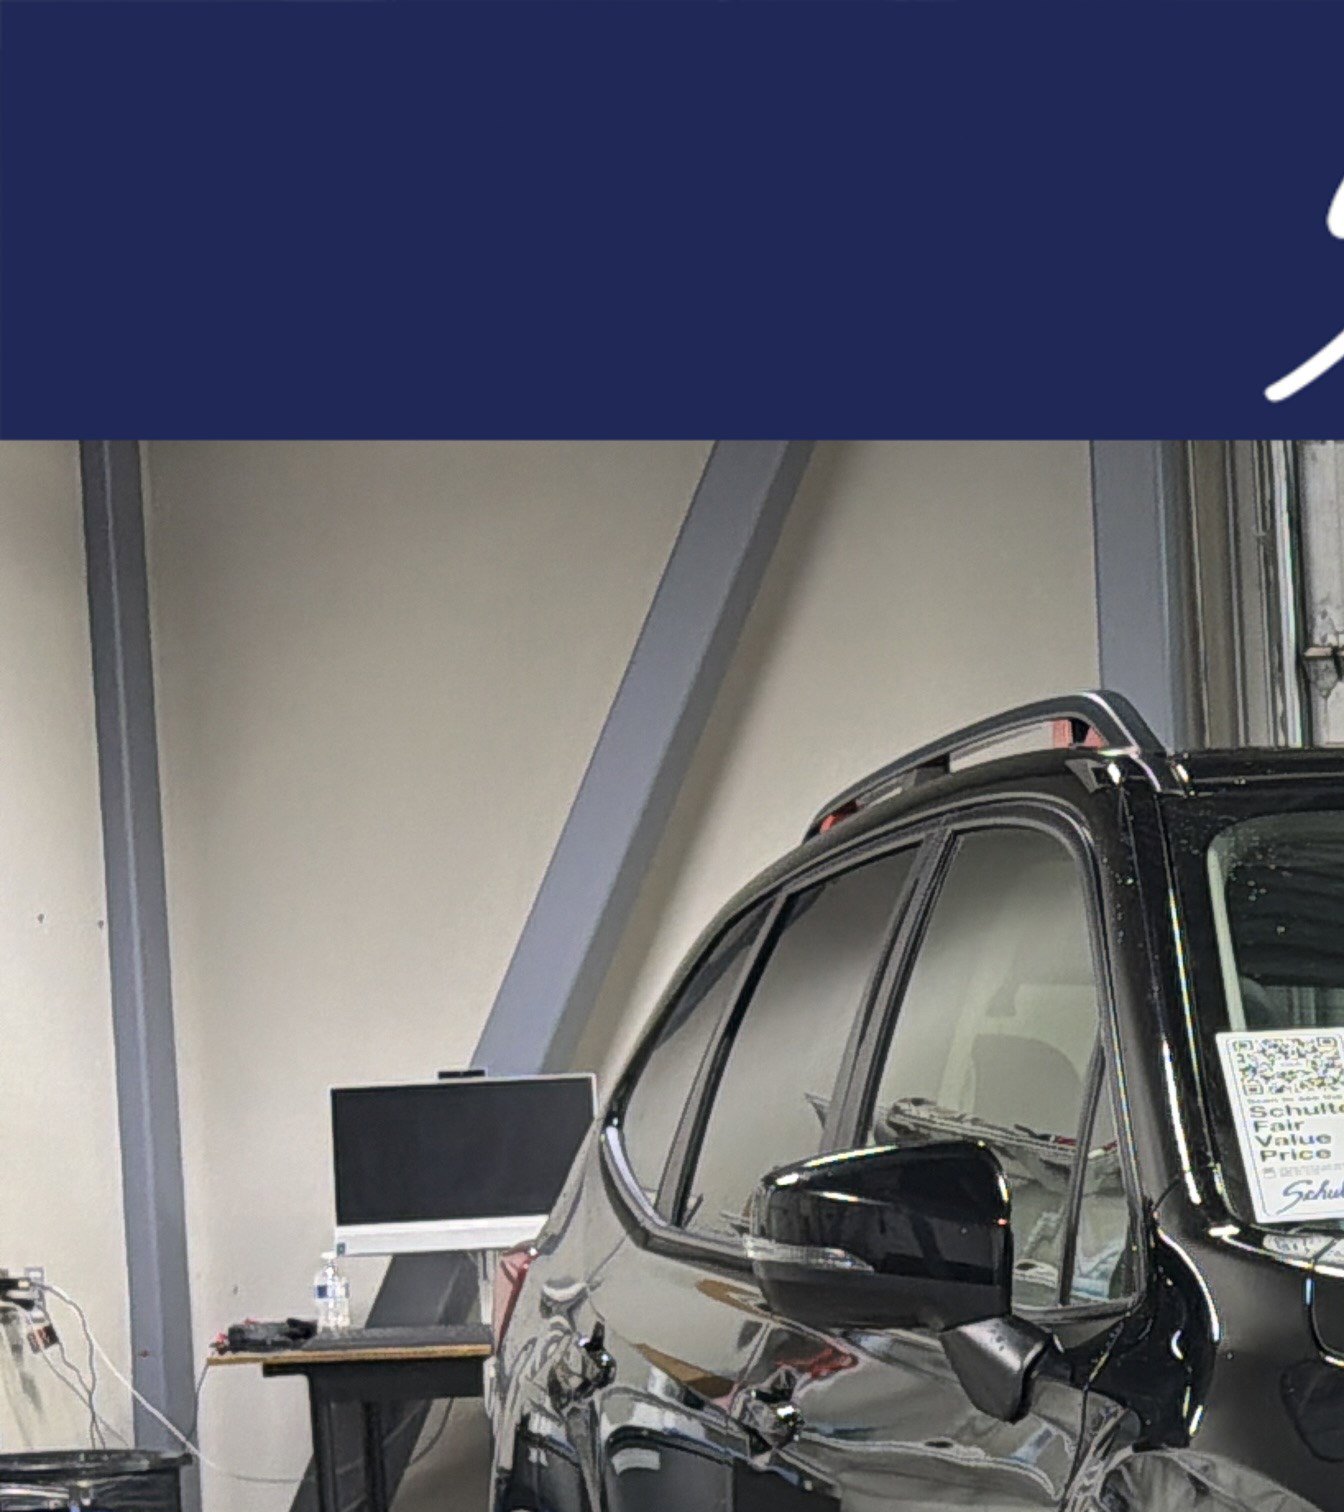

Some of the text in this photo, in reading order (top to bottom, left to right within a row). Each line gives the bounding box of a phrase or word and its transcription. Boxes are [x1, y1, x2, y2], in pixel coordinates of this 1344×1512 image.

[1253, 1119, 1304, 1132] Fair
[1255, 1133, 1332, 1147] Value
[1260, 1148, 1332, 1162] Price
